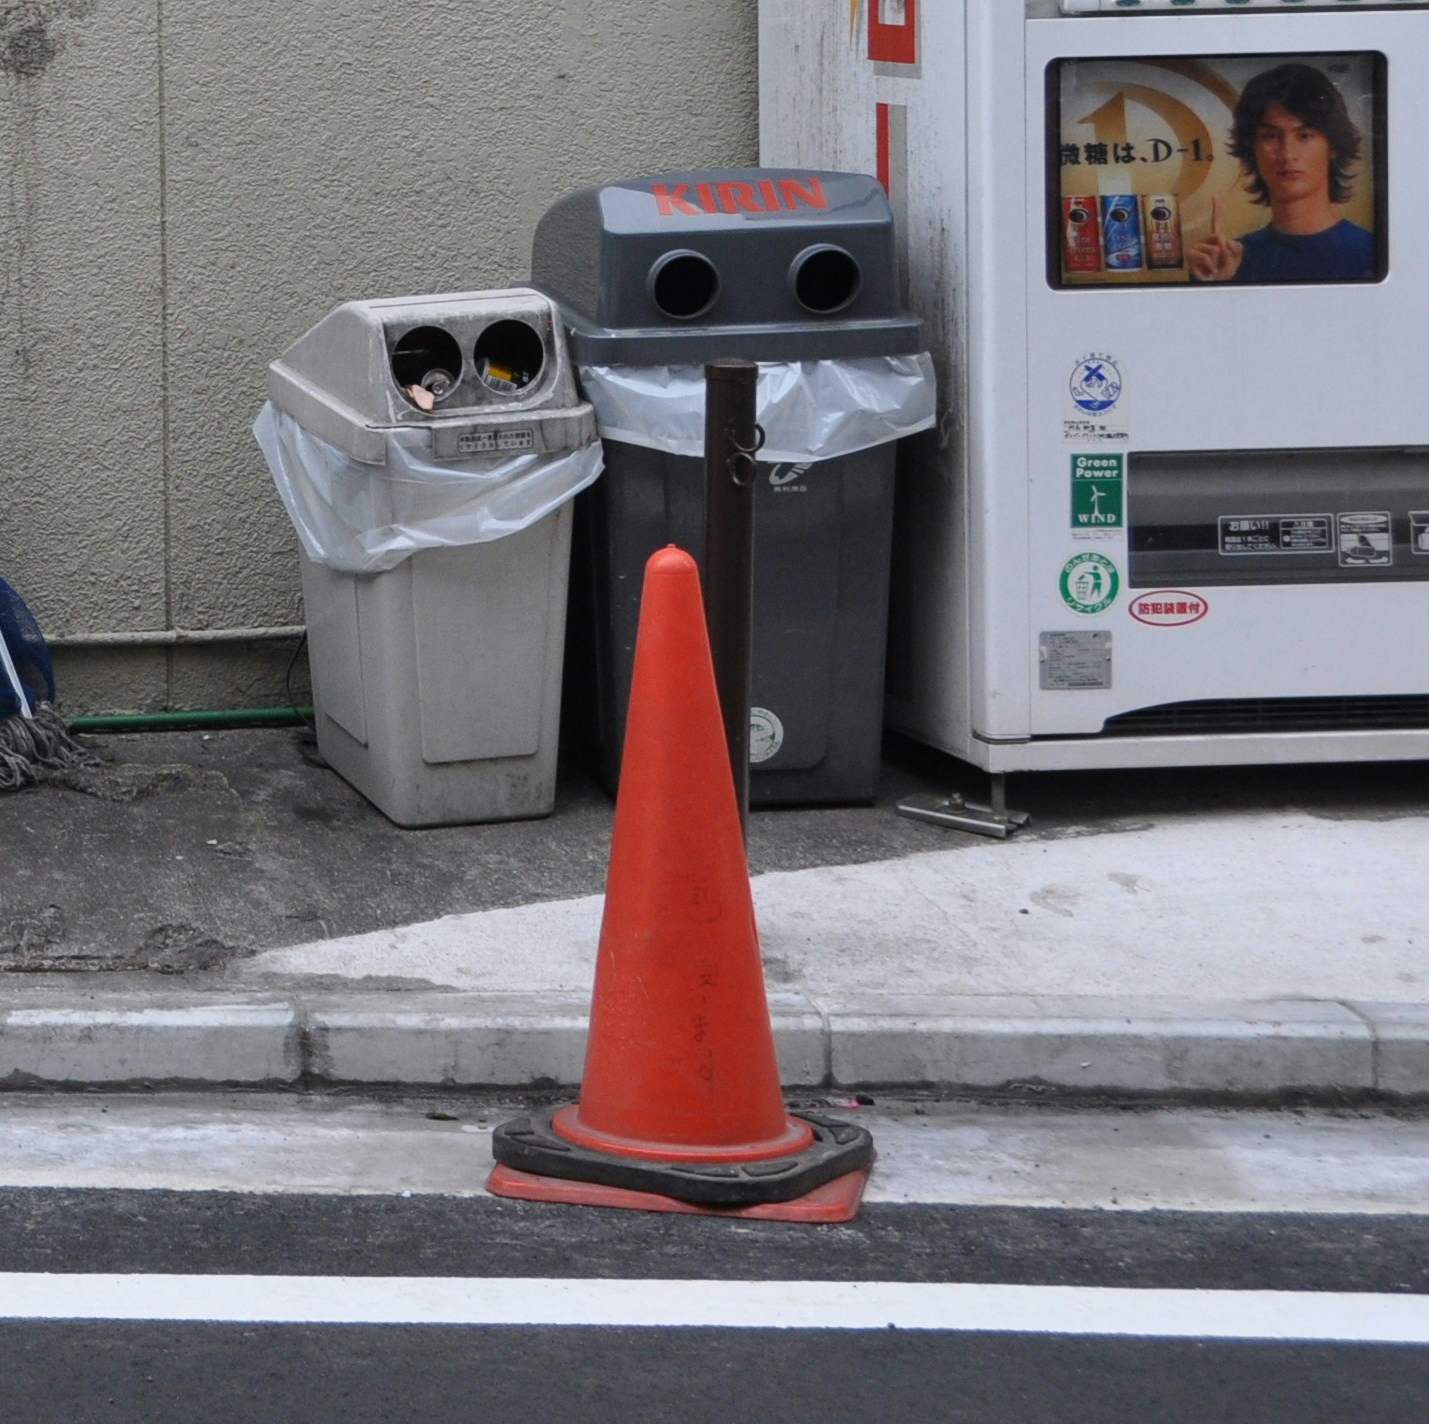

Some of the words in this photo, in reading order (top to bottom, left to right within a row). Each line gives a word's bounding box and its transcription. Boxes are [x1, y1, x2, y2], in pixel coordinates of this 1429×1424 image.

[651, 176, 829, 216] KIRIN
[1076, 456, 1118, 468] Green
[1075, 467, 1119, 479] Power
[1077, 513, 1117, 524] WIND
[1137, 601, 1201, 615] 防犯装置付
